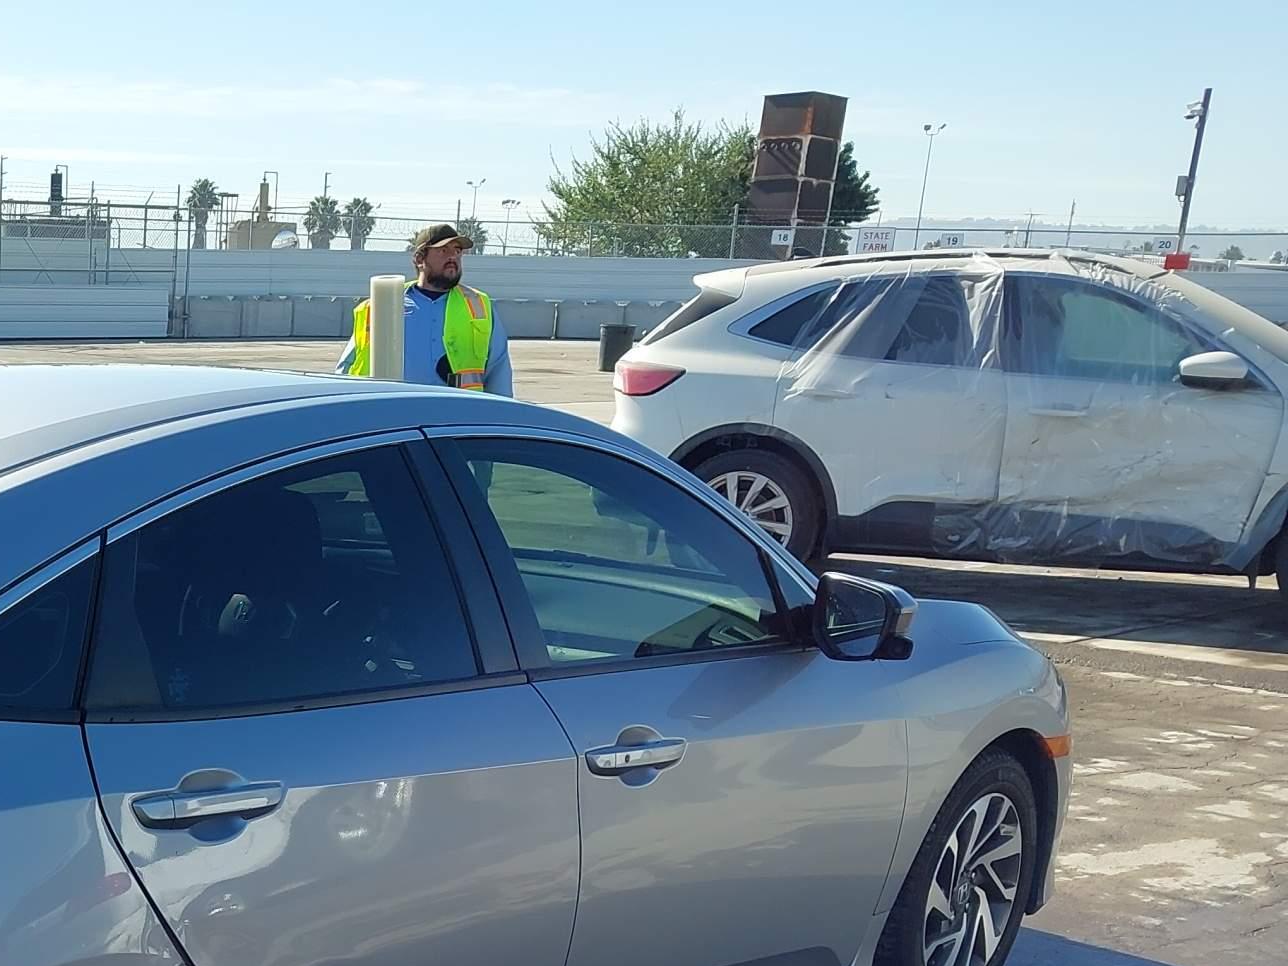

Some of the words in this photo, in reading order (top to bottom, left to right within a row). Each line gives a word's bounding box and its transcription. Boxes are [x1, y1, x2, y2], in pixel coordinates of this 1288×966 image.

[777, 233, 789, 242] 18
[863, 231, 891, 240] STATE
[946, 236, 959, 246] 19
[1158, 240, 1172, 249] 20
[862, 242, 888, 252] FARM
